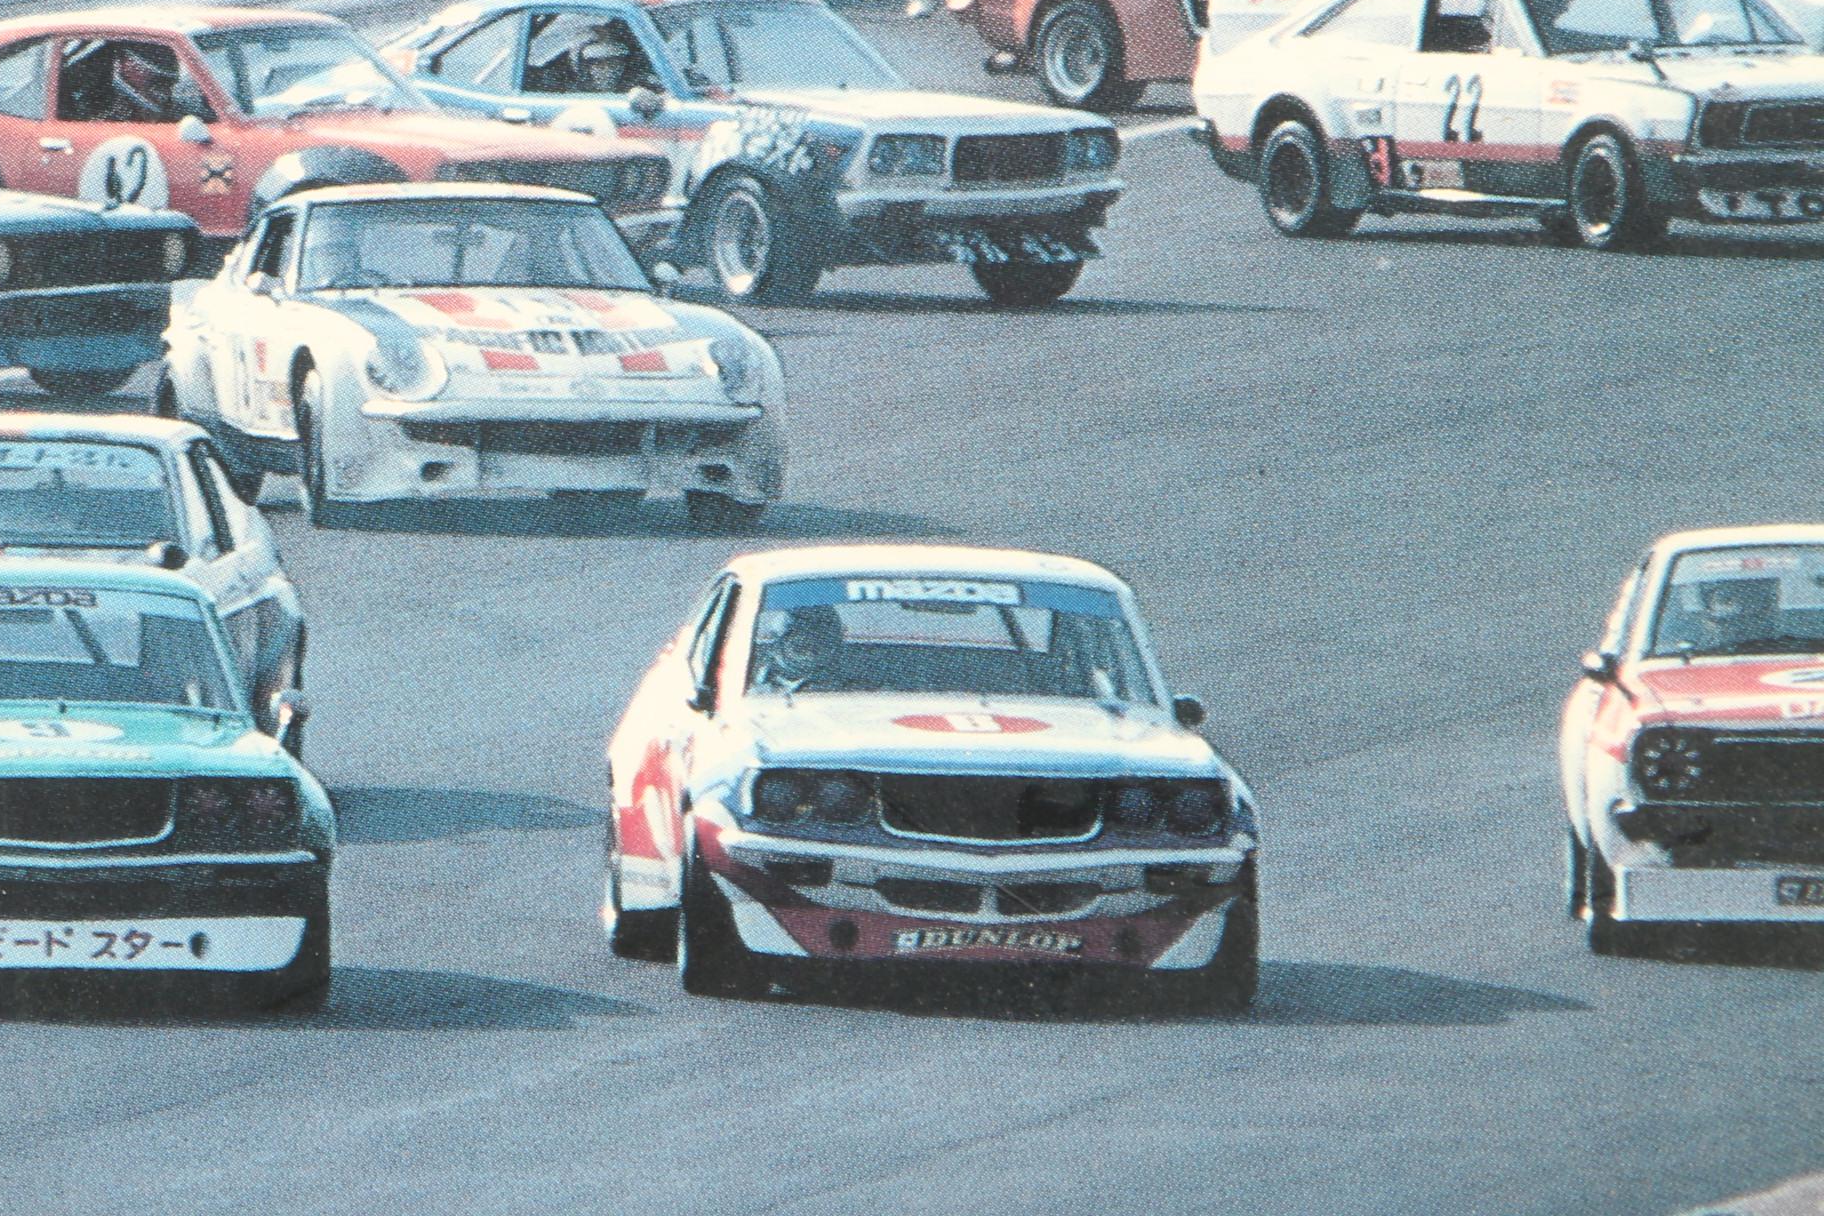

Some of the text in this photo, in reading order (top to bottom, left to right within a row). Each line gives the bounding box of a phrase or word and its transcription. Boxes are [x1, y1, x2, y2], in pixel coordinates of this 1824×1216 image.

[1443, 73, 1484, 142] 22
[846, 580, 1021, 605] mazda
[91, 928, 185, 961] スター
